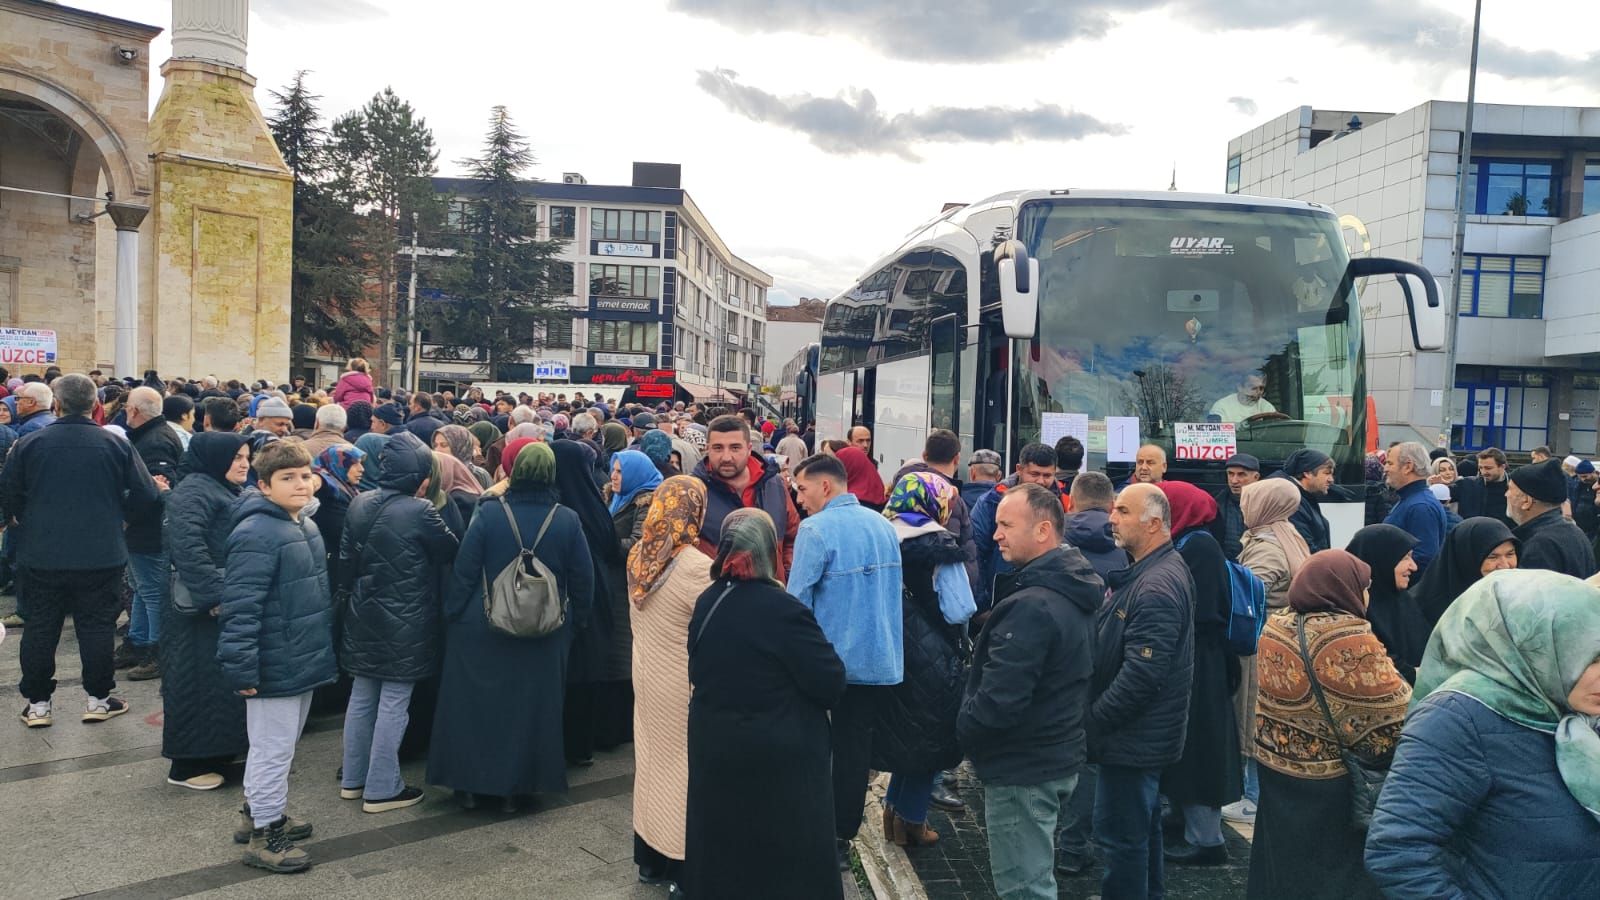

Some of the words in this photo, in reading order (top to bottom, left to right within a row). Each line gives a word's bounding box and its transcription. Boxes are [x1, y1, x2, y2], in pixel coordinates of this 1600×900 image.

[1170, 237, 1224, 248] UYAR
[0, 345, 46, 364] ÜZCE
[1195, 424, 1220, 432] MEYDAN
[1115, 424, 1128, 454] 1
[1177, 443, 1235, 461] DÜZCE
